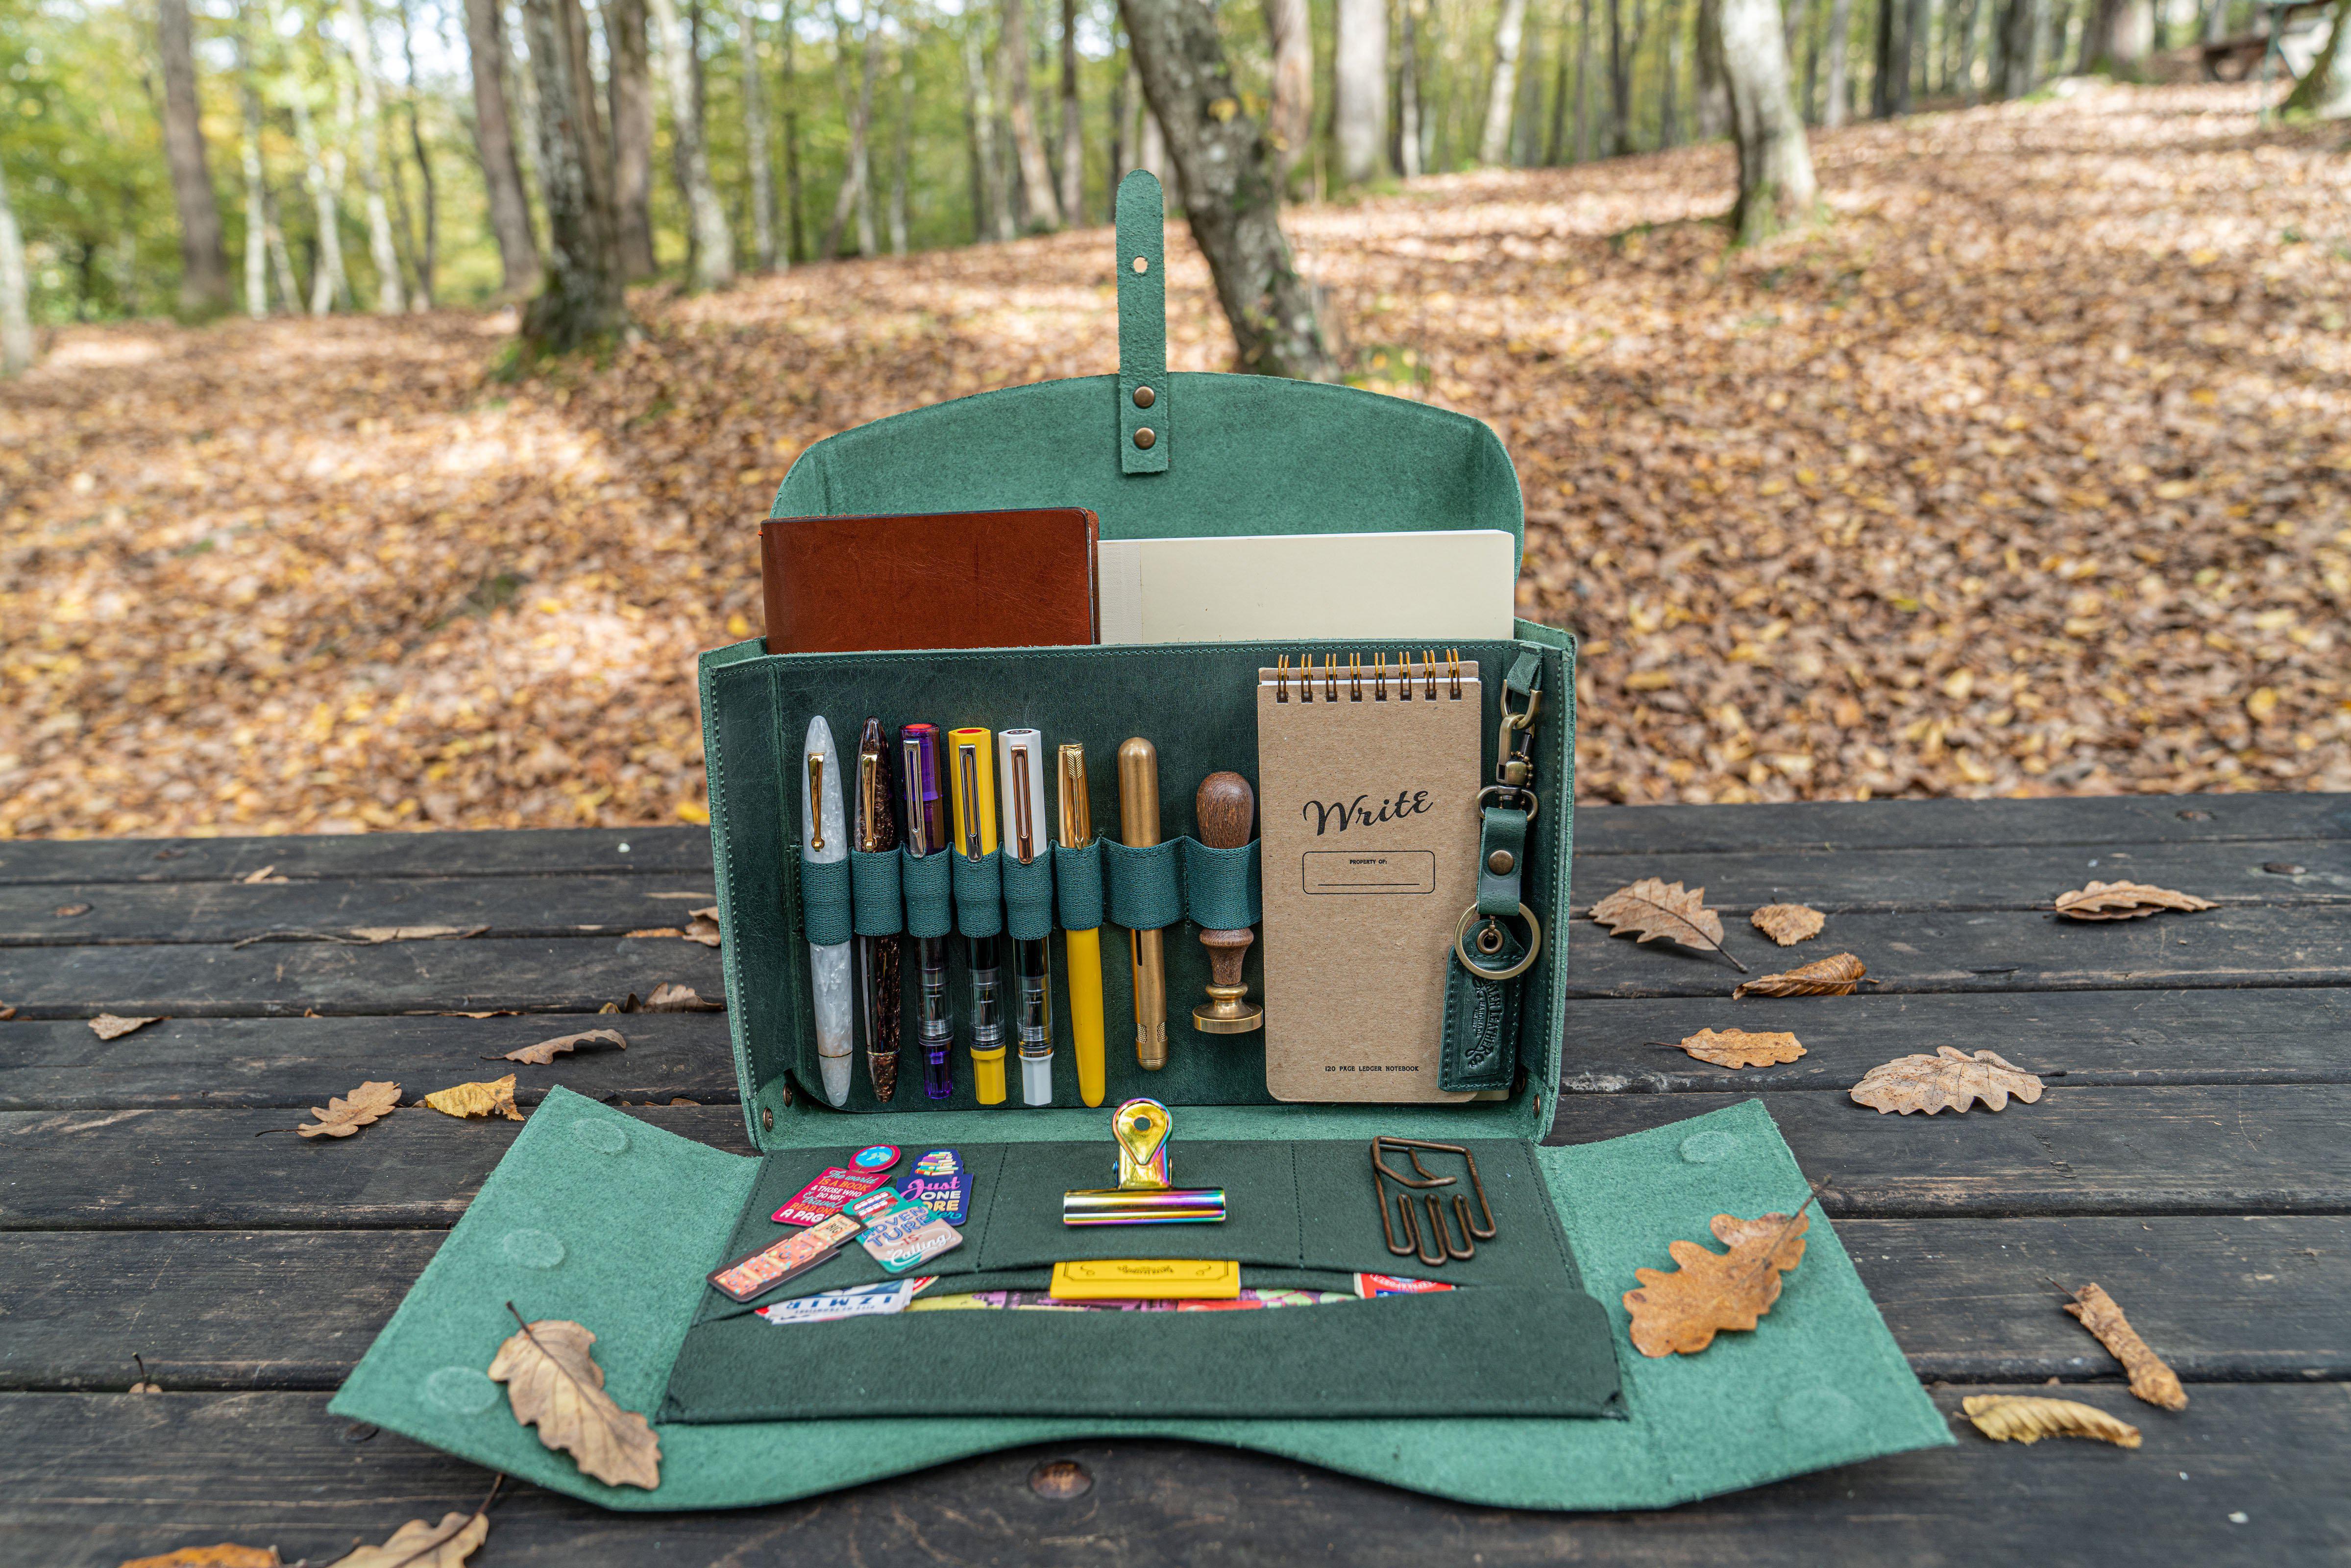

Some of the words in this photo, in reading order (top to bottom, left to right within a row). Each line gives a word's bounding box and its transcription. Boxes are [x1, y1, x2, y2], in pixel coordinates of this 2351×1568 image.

[1303, 790, 1433, 836] Write
[1476, 1001, 1485, 1038] HANDMADE
[1480, 1007, 1503, 1056] LEATHER
[824, 1170, 846, 1179] The
[845, 1176, 880, 1184] world
[817, 1185, 843, 1194] THOSE
[842, 1189, 862, 1198] WHO
[838, 1180, 871, 1192] BOOK
[901, 1176, 960, 1202] Just
[802, 1193, 844, 1208] travel
[920, 1190, 961, 1200] ONE
[789, 1202, 817, 1212] READ
[923, 1200, 960, 1212] ORE
[779, 1208, 794, 1218] A
[792, 1210, 830, 1223] PAG
[861, 1205, 926, 1240] ADVEN
[826, 1223, 843, 1233] BIG
[867, 1214, 935, 1247] TURE
[904, 1234, 919, 1245] IS
[886, 1233, 948, 1267] Calling
[786, 1296, 891, 1309] IZMIR
